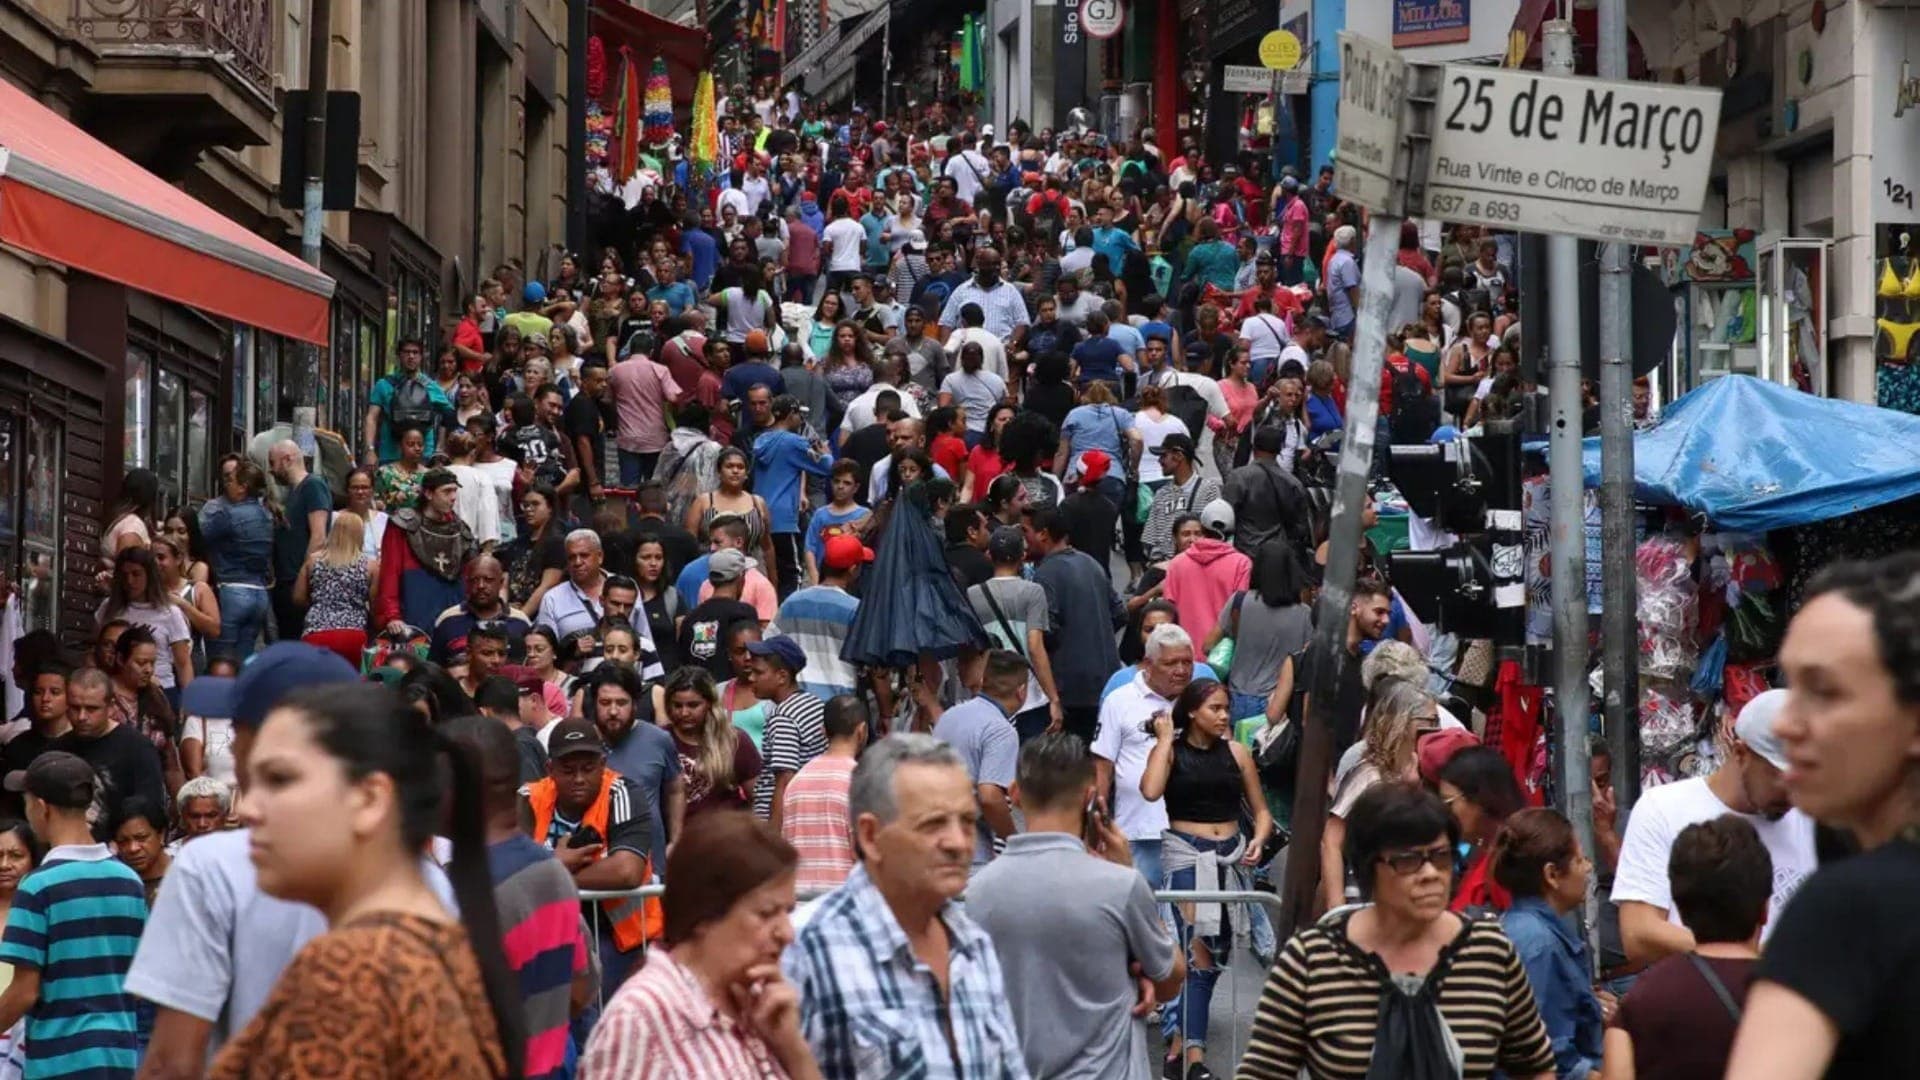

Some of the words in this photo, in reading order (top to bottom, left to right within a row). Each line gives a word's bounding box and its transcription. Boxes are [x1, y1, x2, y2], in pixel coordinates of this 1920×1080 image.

[1445, 76, 1496, 134] 25
[1509, 79, 1564, 141] de
[1578, 88, 1704, 170] Março
[1436, 156, 1471, 179] Rua
[1476, 161, 1523, 186] Vinte
[1527, 172, 1540, 187] e
[1544, 169, 1597, 194] Cinco
[1601, 176, 1624, 198] de
[1629, 179, 1680, 206] Março
[1882, 176, 1913, 210] 121
[1431, 193, 1465, 214] 637
[1468, 202, 1481, 217] a
[1485, 201, 1521, 222] 693
